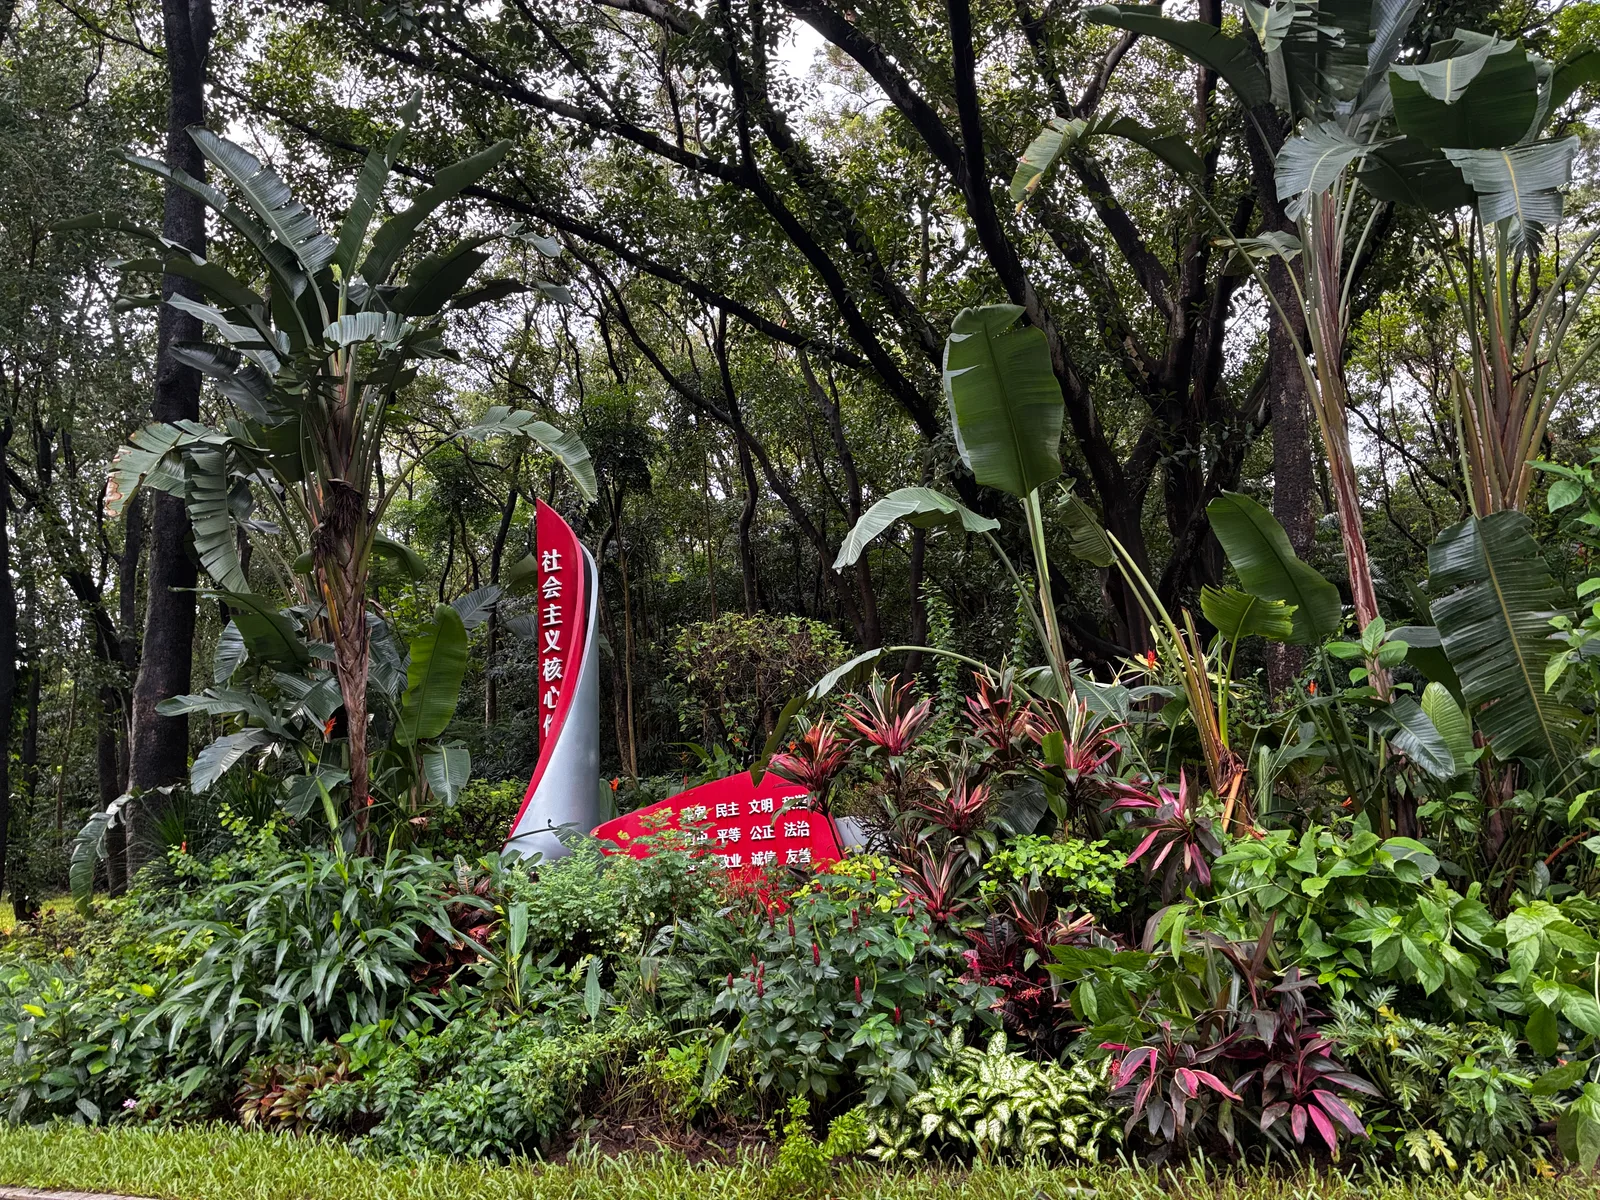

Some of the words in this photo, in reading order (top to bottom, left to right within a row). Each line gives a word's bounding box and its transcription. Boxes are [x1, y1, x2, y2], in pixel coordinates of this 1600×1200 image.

[681, 806, 708, 821] 强
[715, 801, 740, 818] 民主
[748, 797, 774, 815] 文明
[716, 827, 742, 843] 平等
[749, 824, 776, 840] 公正
[783, 820, 811, 838] 法治
